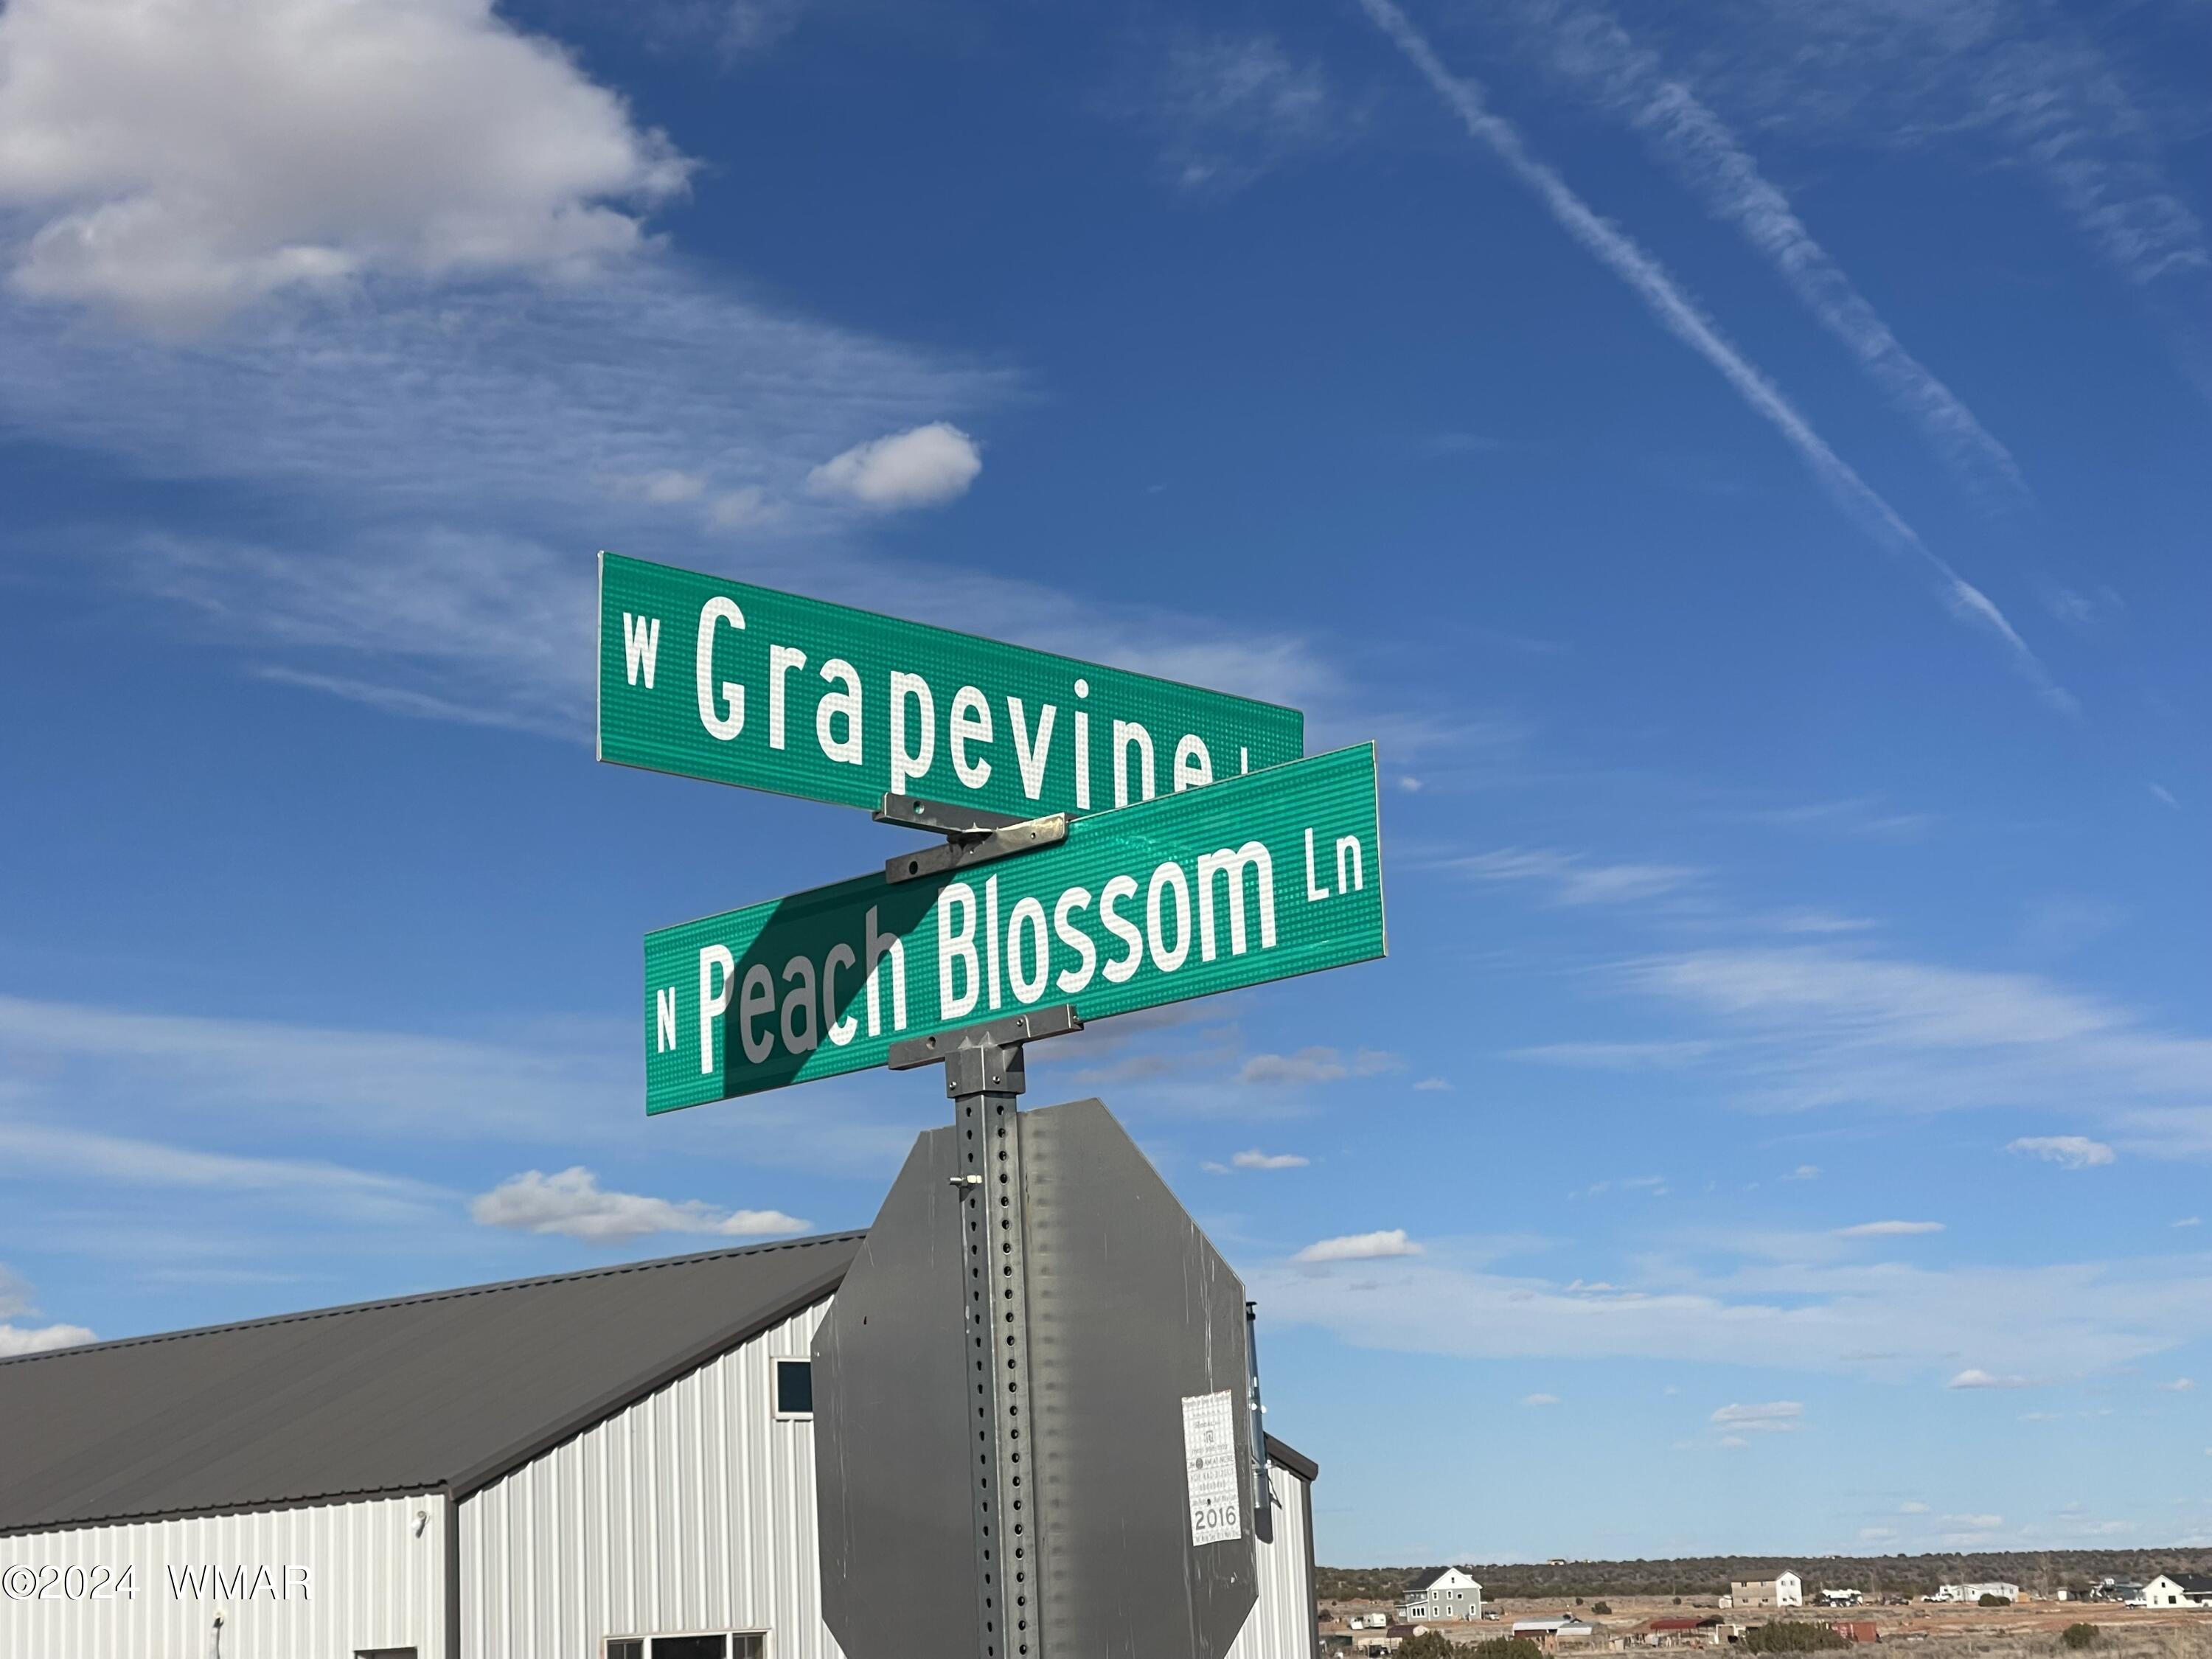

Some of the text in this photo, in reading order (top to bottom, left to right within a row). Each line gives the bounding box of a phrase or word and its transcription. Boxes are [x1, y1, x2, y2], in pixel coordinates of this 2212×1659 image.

[623, 597, 1214, 811] W Grapevine
[657, 828, 1363, 1074] N Peach Blossom Ln
[1195, 1506, 1237, 1530] 2016
